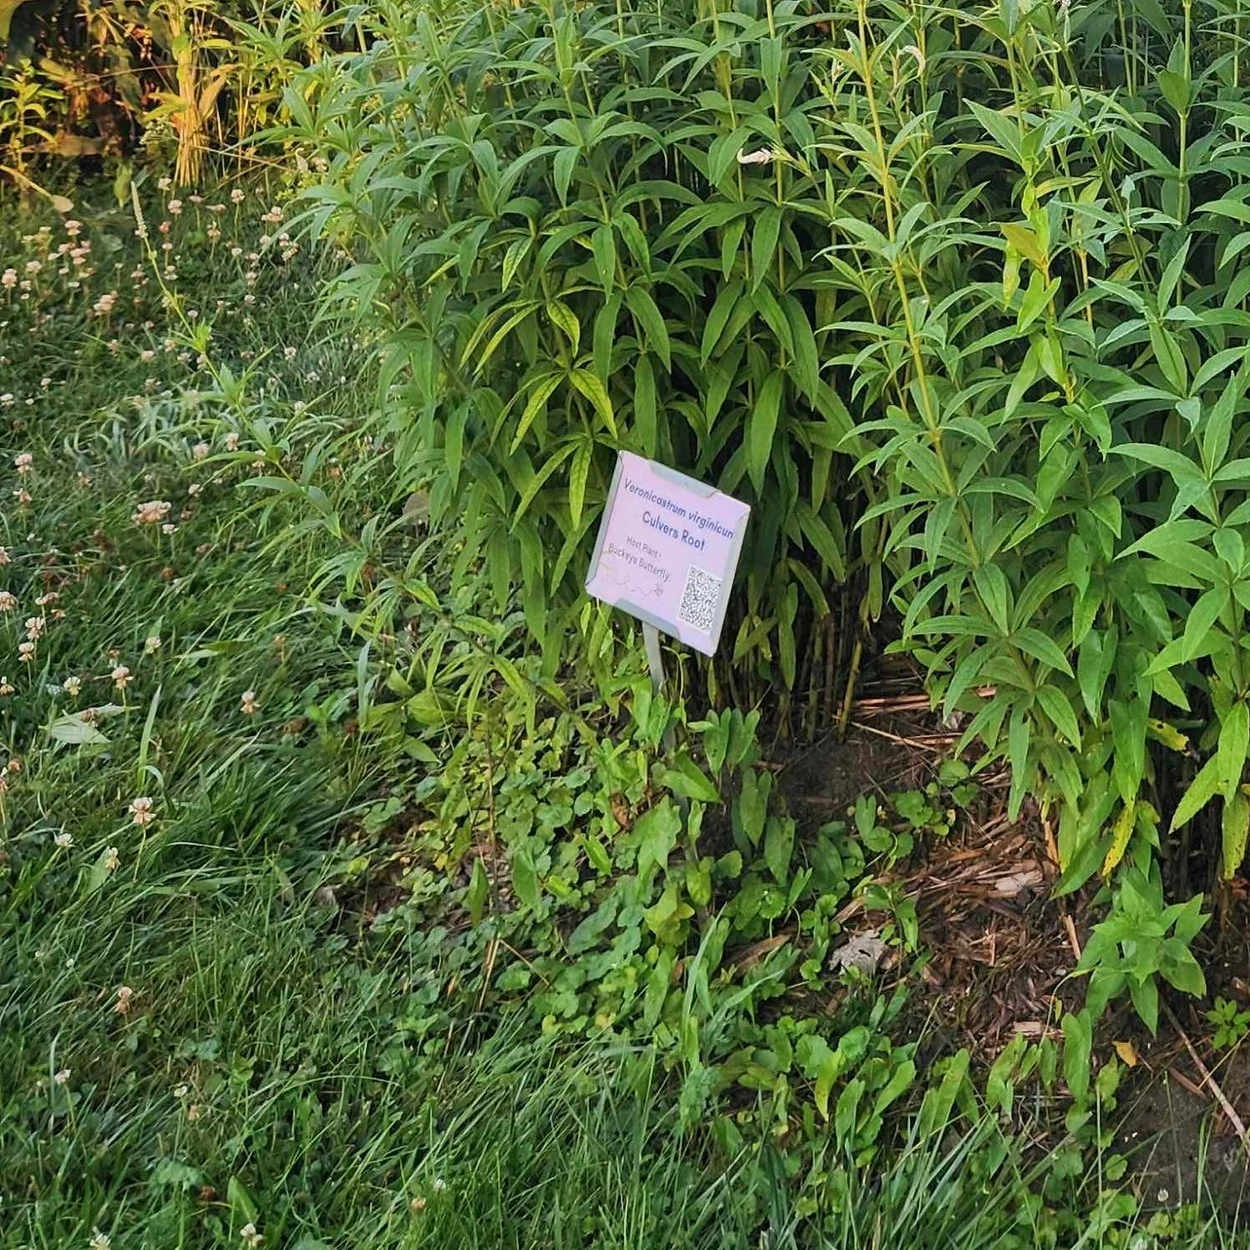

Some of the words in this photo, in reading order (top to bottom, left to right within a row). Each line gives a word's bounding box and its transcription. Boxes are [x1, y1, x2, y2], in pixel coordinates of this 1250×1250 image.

[624, 477, 687, 517] Veronicastrum
[626, 536, 641, 549] Host
[642, 511, 679, 539] Culvers
[681, 531, 705, 551] Root
[608, 543, 638, 565] Buckeye
